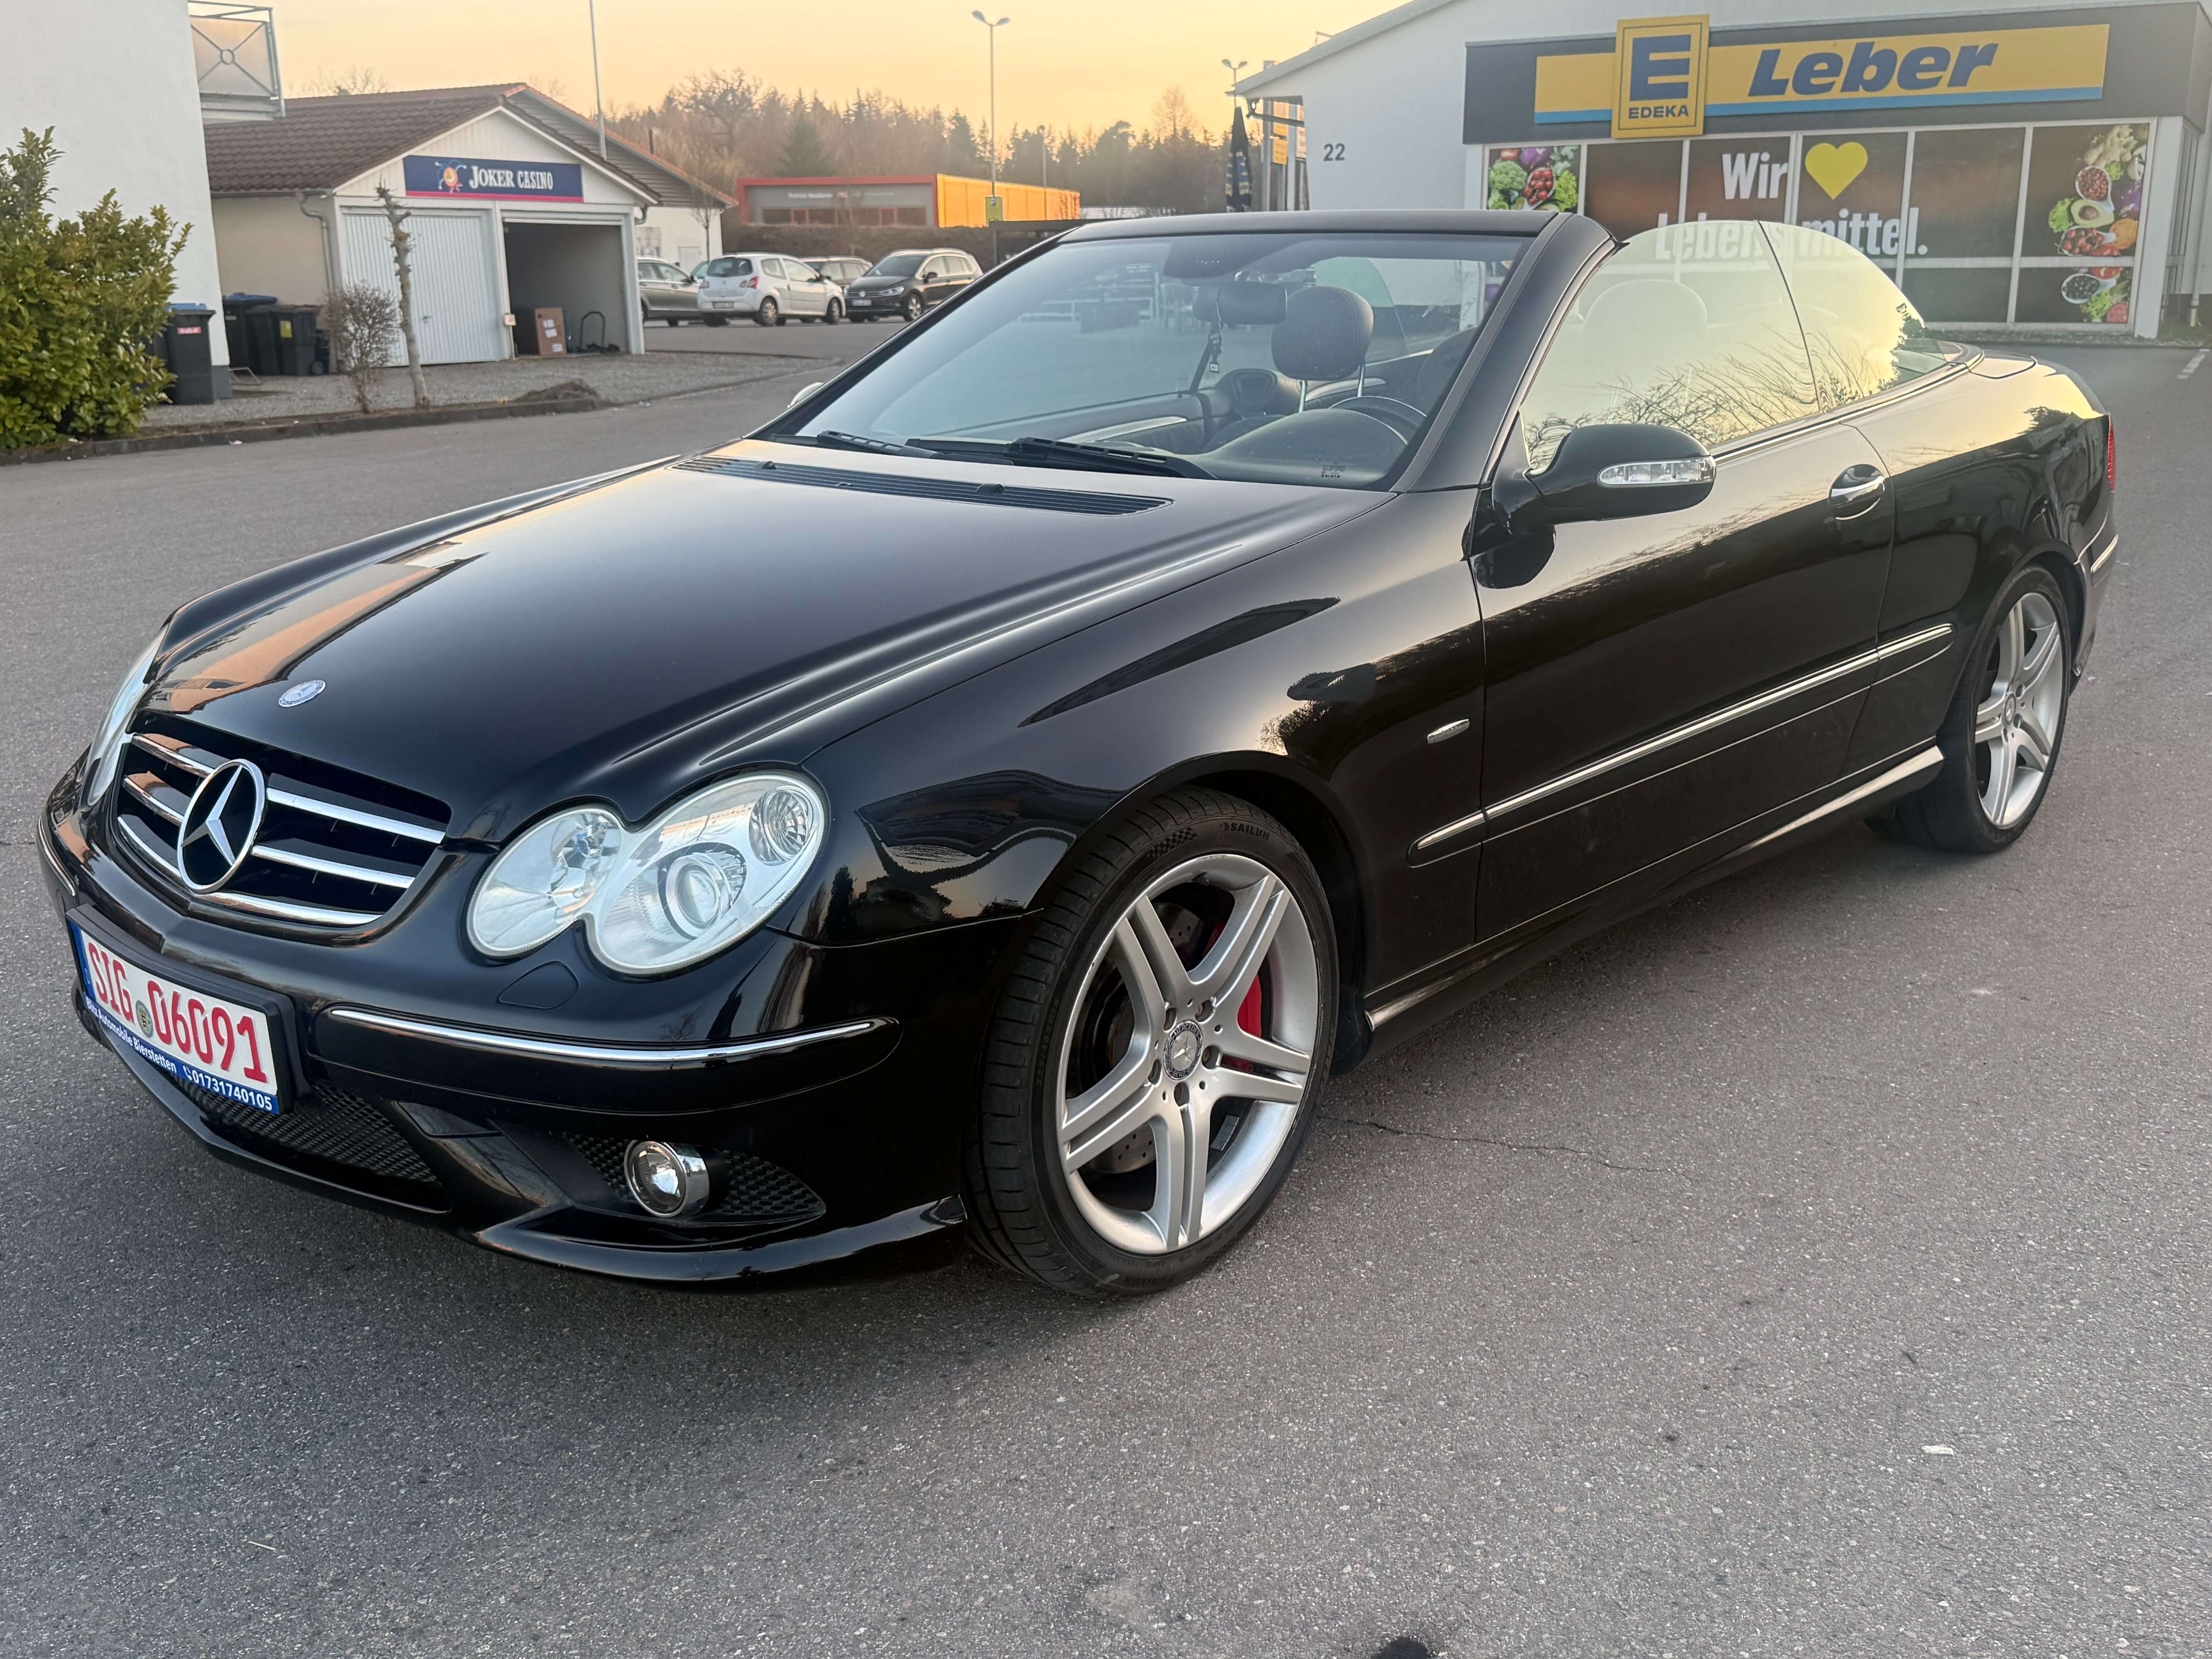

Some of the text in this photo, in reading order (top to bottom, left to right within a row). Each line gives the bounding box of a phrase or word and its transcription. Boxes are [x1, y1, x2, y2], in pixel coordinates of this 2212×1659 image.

[1629, 34, 1692, 101] E
[1748, 41, 1999, 97] Leber
[1628, 105, 1689, 119] EDEKA
[1323, 143, 1345, 161] 22
[1722, 151, 1788, 200] Wir
[469, 165, 554, 190] JOKER CASINO
[1230, 823, 1270, 841] SAILUN
[88, 941, 268, 1084] SIG 06091
[133, 1037, 177, 1073] Bierstetten
[192, 1069, 272, 1111] 01731740105
